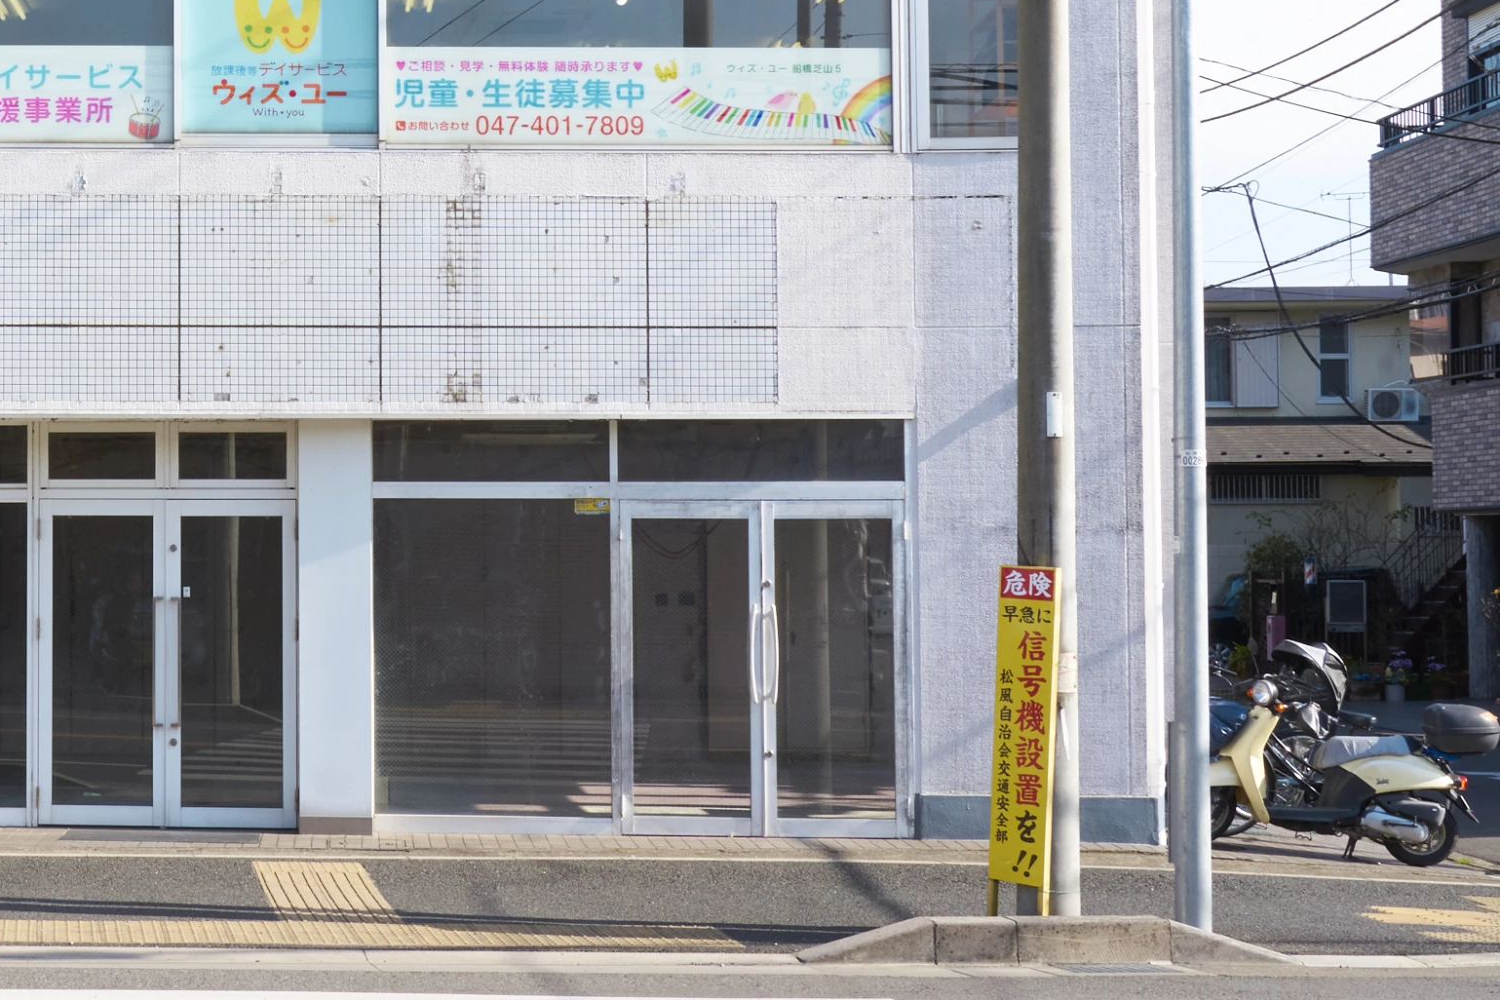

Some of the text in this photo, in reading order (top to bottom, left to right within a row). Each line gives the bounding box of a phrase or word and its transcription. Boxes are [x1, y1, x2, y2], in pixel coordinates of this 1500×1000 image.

[212, 78, 347, 105] ウィズ・ユー
[395, 78, 645, 109] 児童・生徒募集中
[407, 115, 644, 136] お問い合わせ 047-401-7809
[1002, 570, 1052, 598] 危険
[1002, 605, 1051, 624] 早急に
[996, 668, 1014, 844] 松風自治会交通安全部
